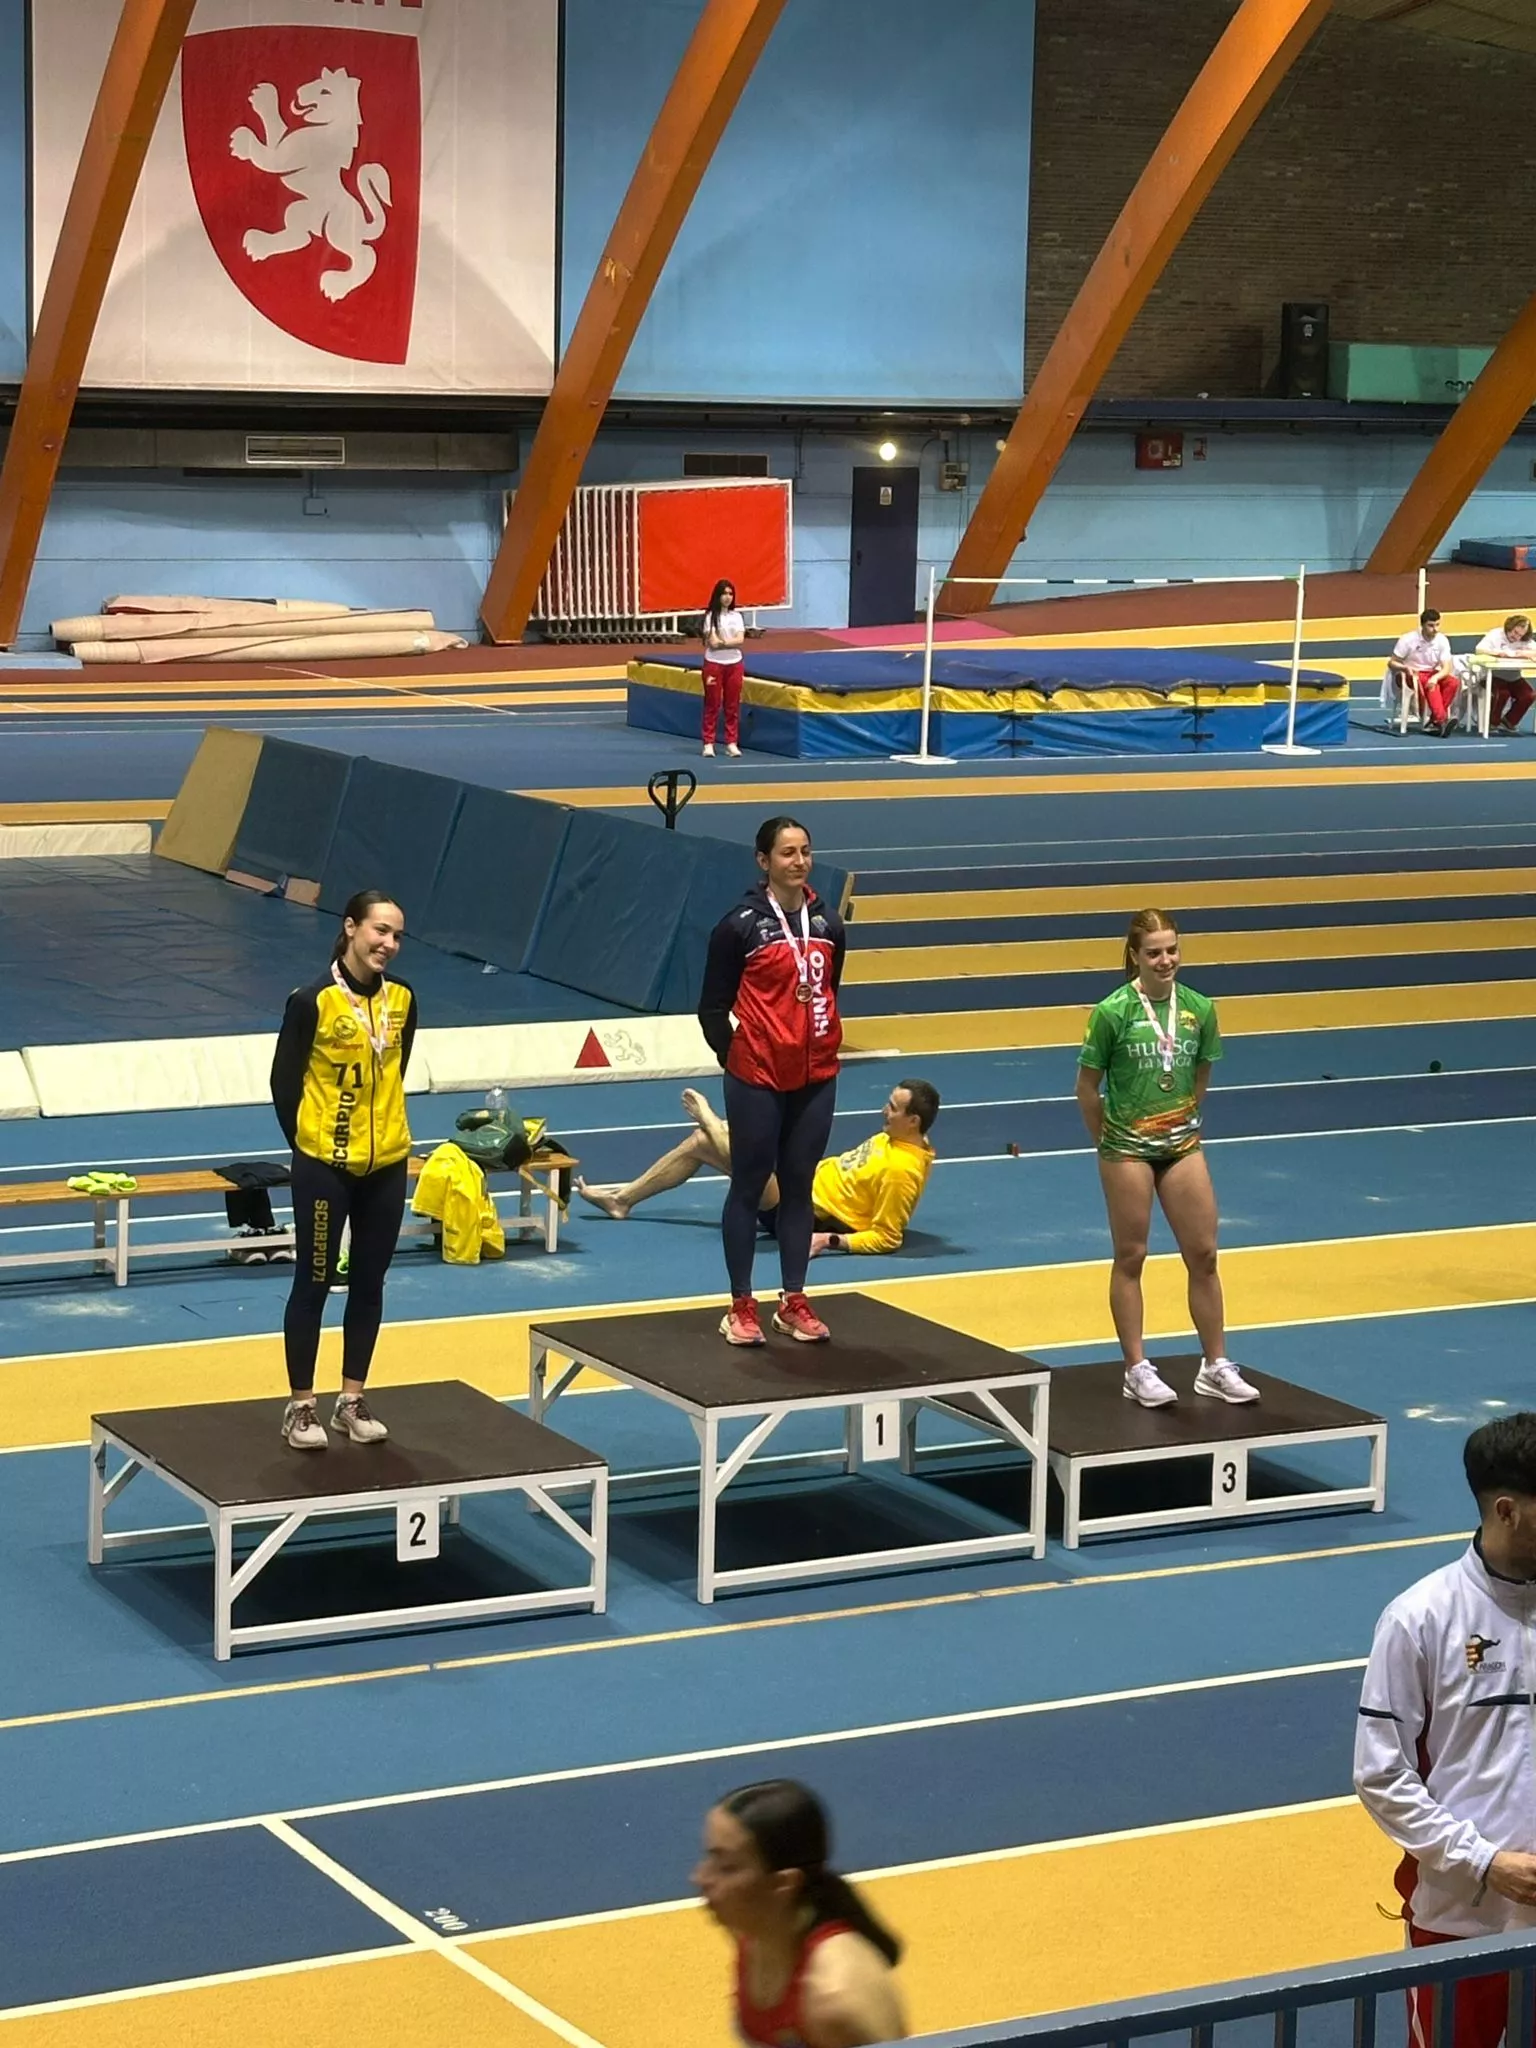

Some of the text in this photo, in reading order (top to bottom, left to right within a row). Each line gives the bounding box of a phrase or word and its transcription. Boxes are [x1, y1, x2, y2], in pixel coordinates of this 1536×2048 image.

[331, 1062, 363, 1089] 71
[876, 1413, 883, 1446] 1
[1222, 1461, 1236, 1493] 3
[409, 1511, 426, 1546] 2
[422, 1907, 468, 1931] 200
